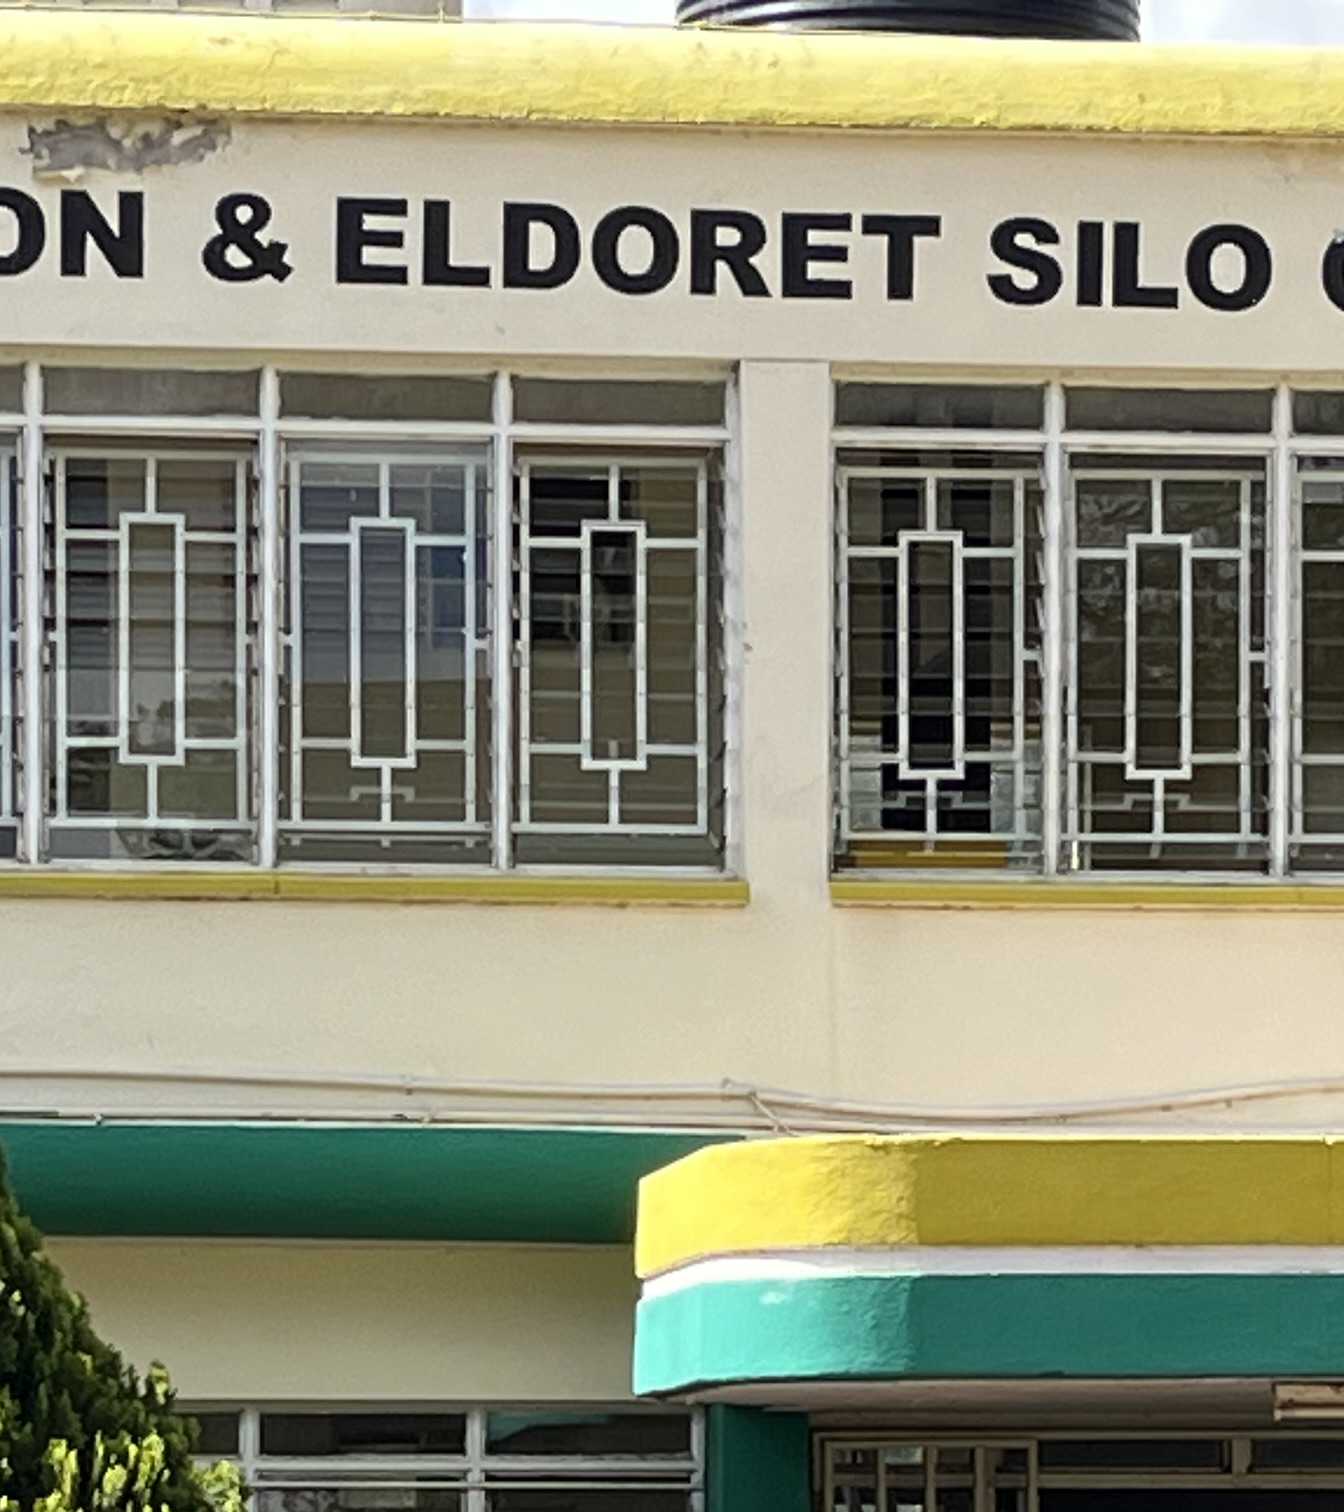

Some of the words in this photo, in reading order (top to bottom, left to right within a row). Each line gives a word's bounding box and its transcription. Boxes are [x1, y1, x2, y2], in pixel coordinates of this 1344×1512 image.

[202, 192, 292, 285] &
[335, 196, 942, 301] ELDORET
[986, 216, 1273, 313] SILO
